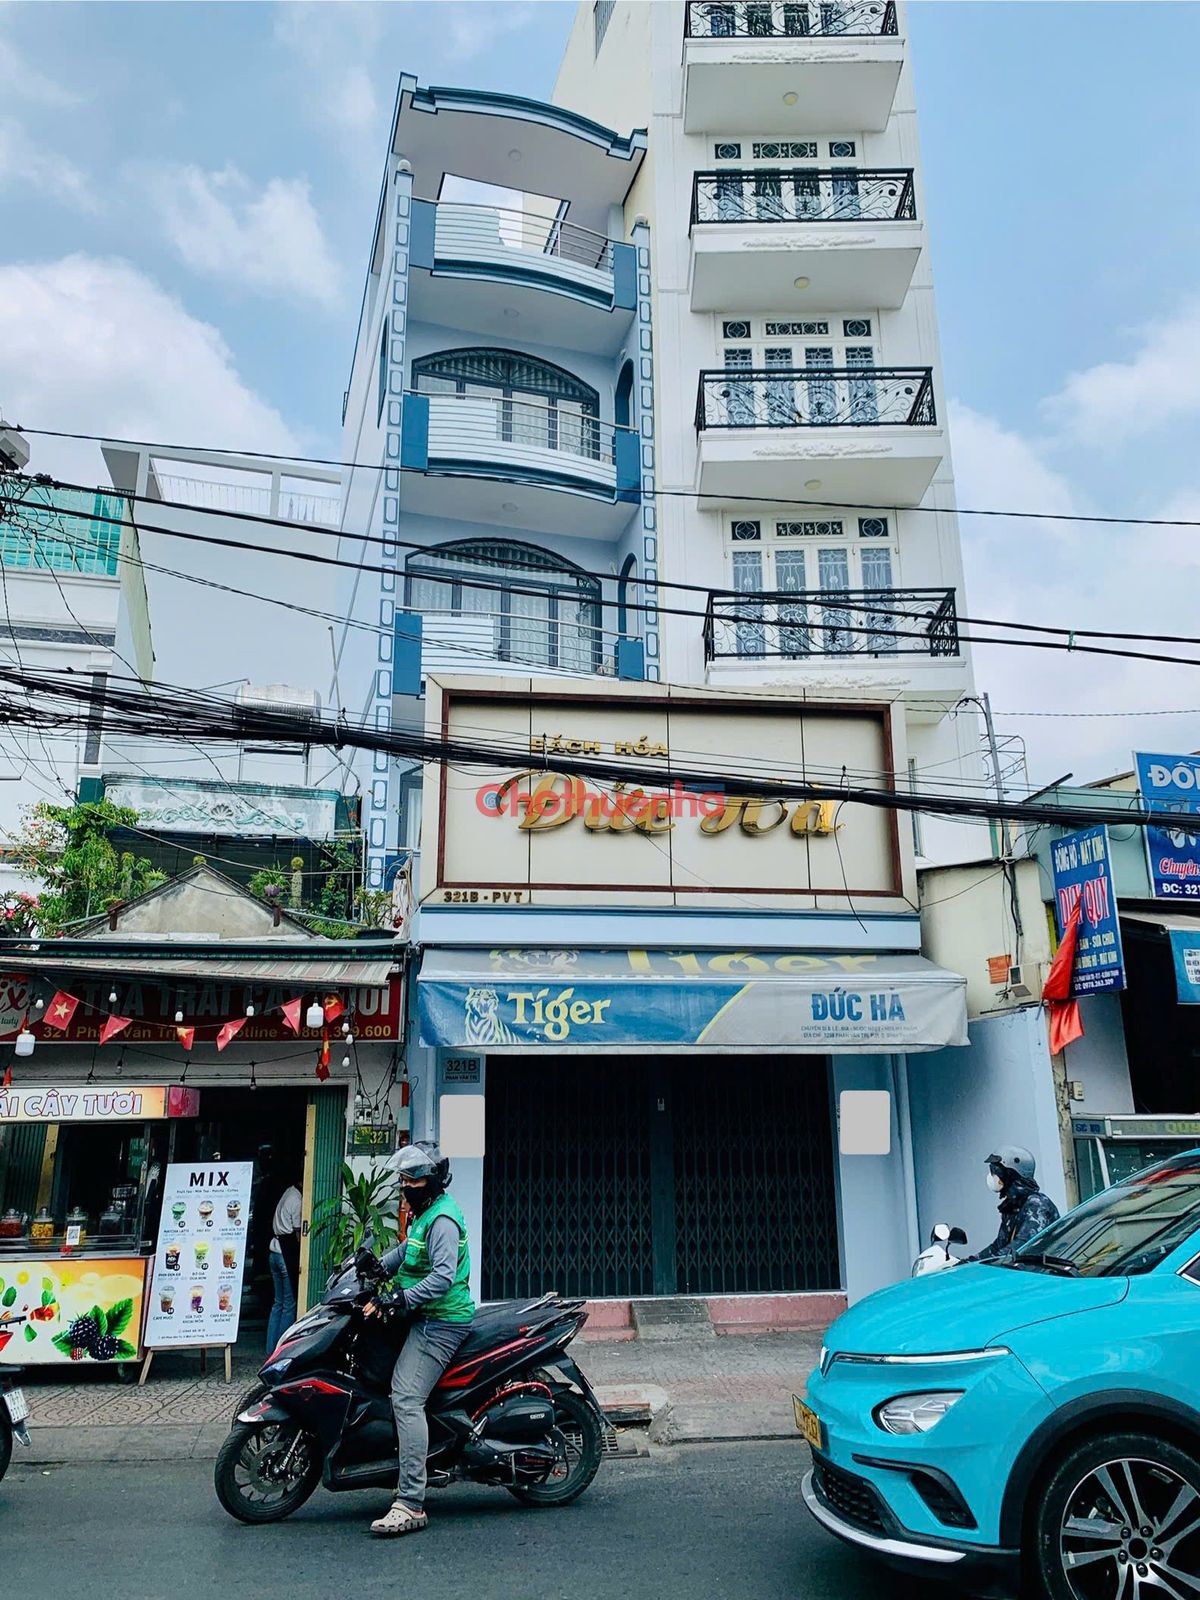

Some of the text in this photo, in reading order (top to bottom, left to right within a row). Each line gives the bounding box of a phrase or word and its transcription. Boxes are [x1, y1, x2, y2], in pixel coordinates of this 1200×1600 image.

[531, 735, 669, 757] BÁCH HÓA
[443, 891, 479, 903] 321B
[492, 891, 523, 903] PVT
[811, 986, 862, 1021] ĐỨC
[446, 1059, 477, 1072] 321B
[24, 1088, 78, 1117] CÂY
[83, 1091, 142, 1116] TƯƠI
[369, 1130, 390, 1144] 321
[189, 1171, 230, 1187] MIX
